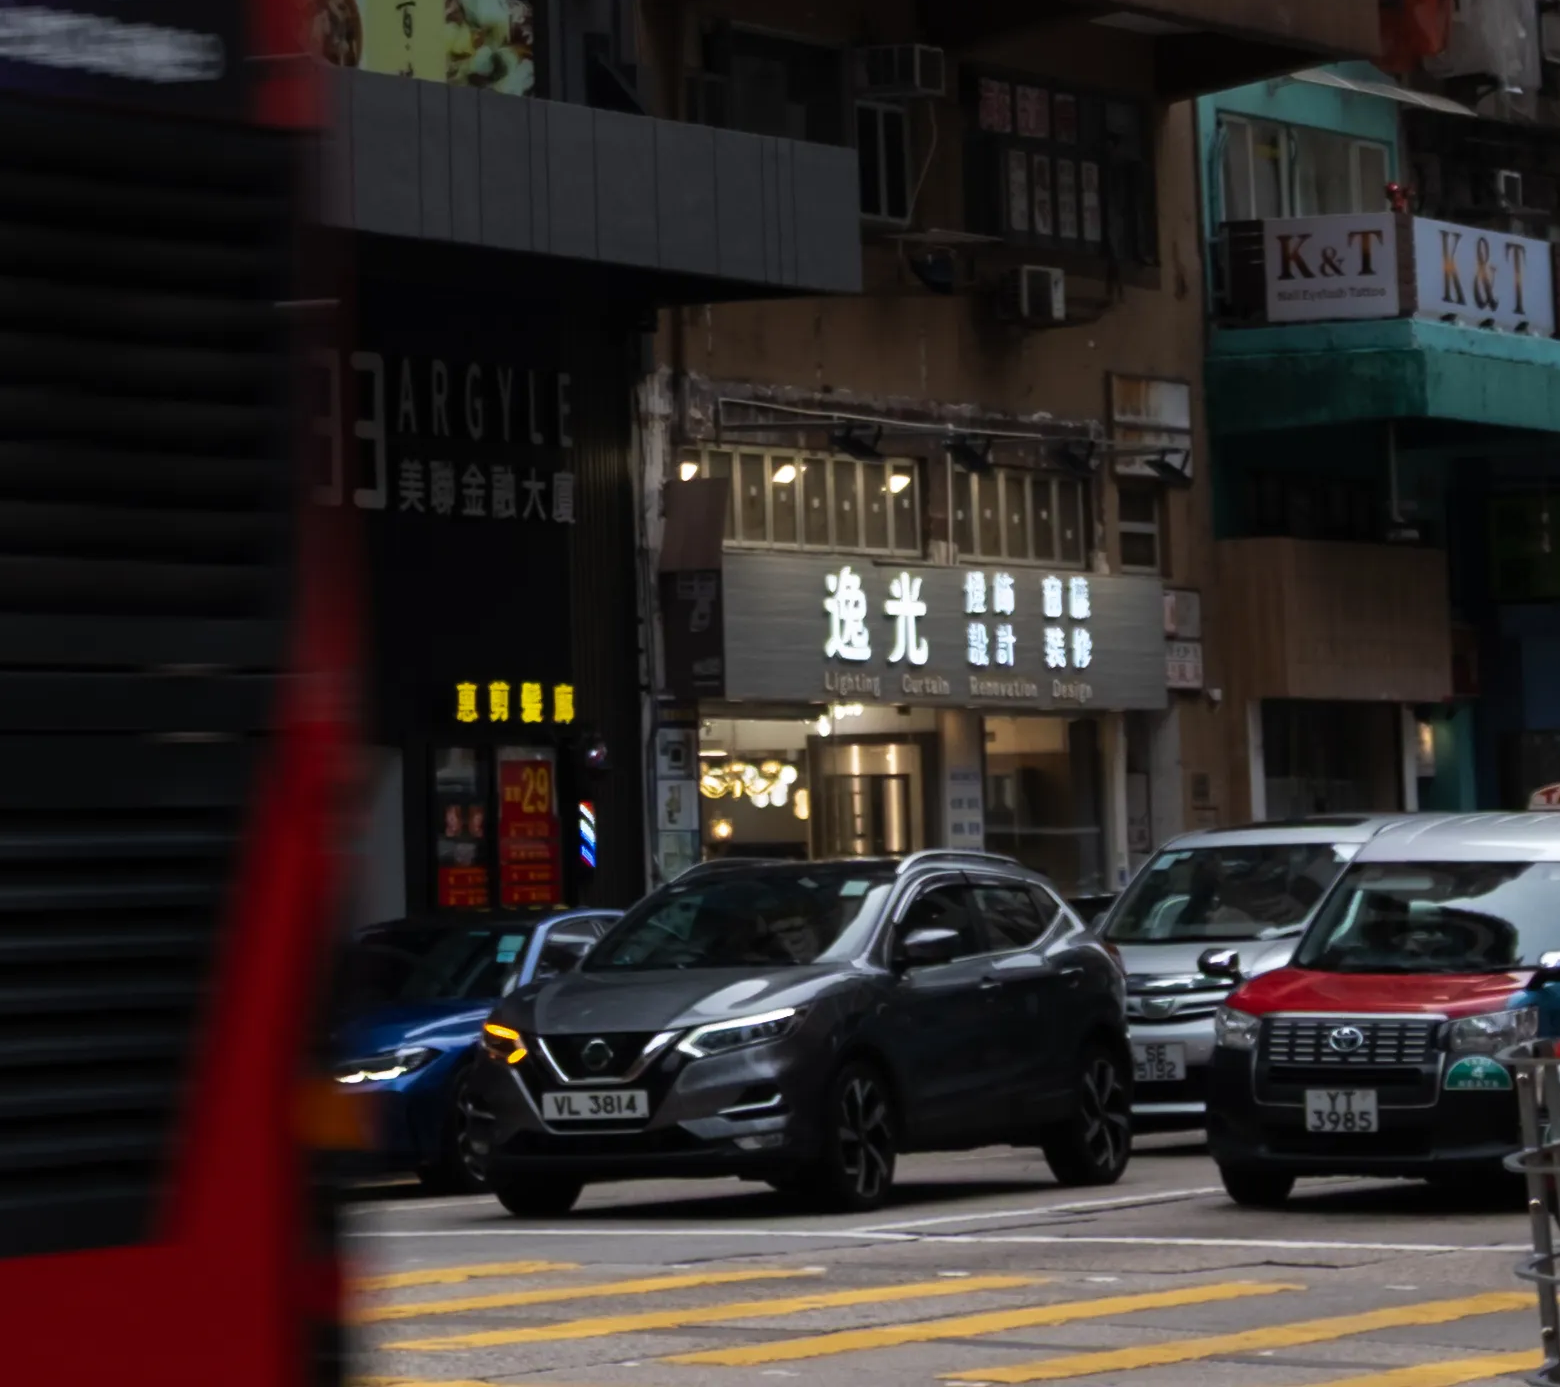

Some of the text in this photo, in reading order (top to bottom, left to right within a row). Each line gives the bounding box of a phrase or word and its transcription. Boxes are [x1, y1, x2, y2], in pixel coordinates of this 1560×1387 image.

[1276, 230, 1385, 281] K&T
[1439, 229, 1528, 315] K&T
[395, 356, 574, 449] ARGYLE
[823, 566, 930, 666] 逸光
[966, 622, 1018, 667] 設計
[824, 672, 1094, 704] Lighting Curtain Renovation Design
[553, 1093, 638, 1116] VL 3814
[1312, 1110, 1372, 1131] 3985
[1326, 1091, 1356, 1112] YT
